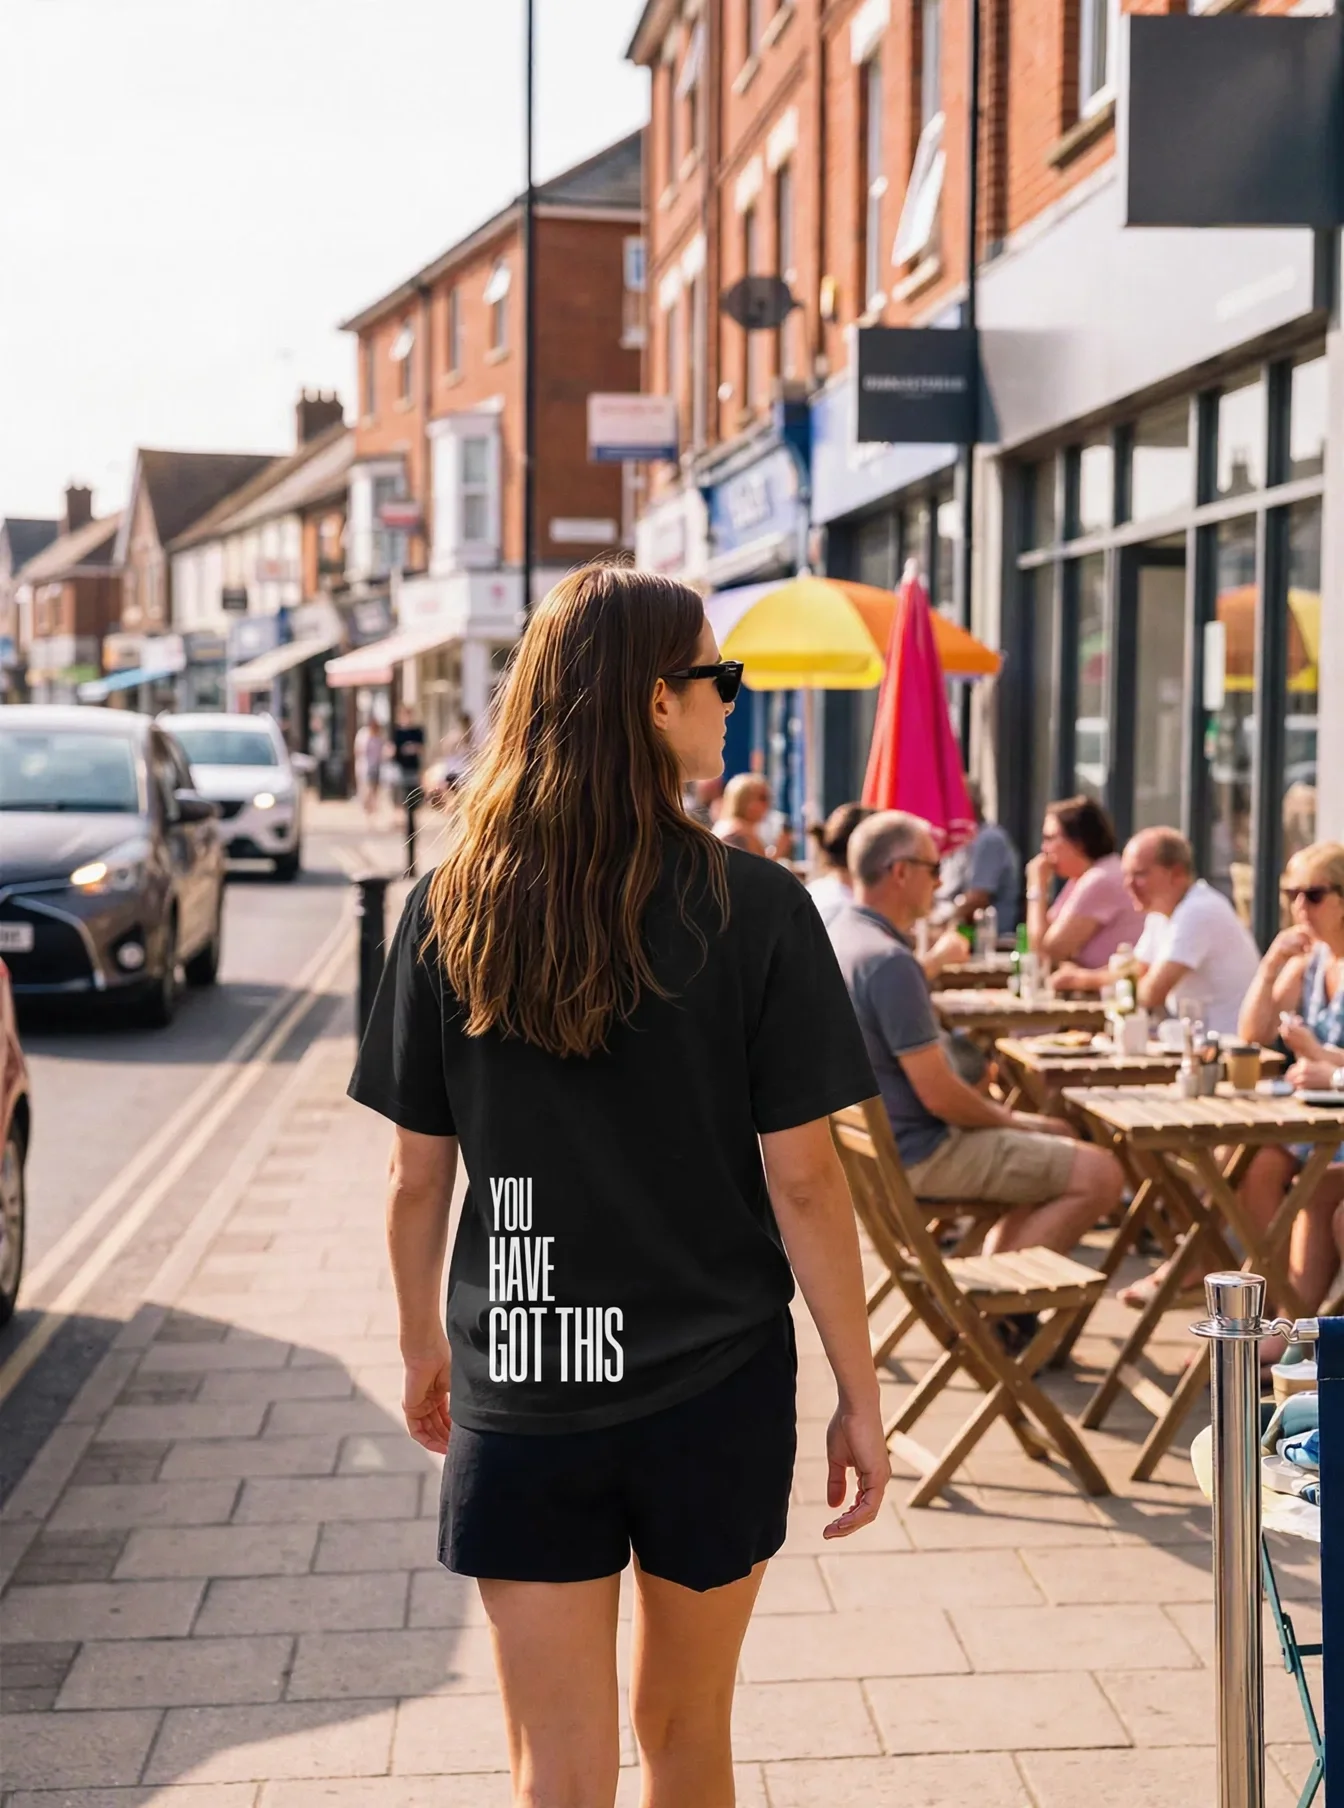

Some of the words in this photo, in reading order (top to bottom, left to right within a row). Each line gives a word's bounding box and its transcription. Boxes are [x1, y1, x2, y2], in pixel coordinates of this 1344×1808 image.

[490, 1177, 532, 1231] YOU
[489, 1237, 555, 1301] HAVE
[489, 1307, 547, 1382] GOT
[555, 1307, 623, 1382] THIS
